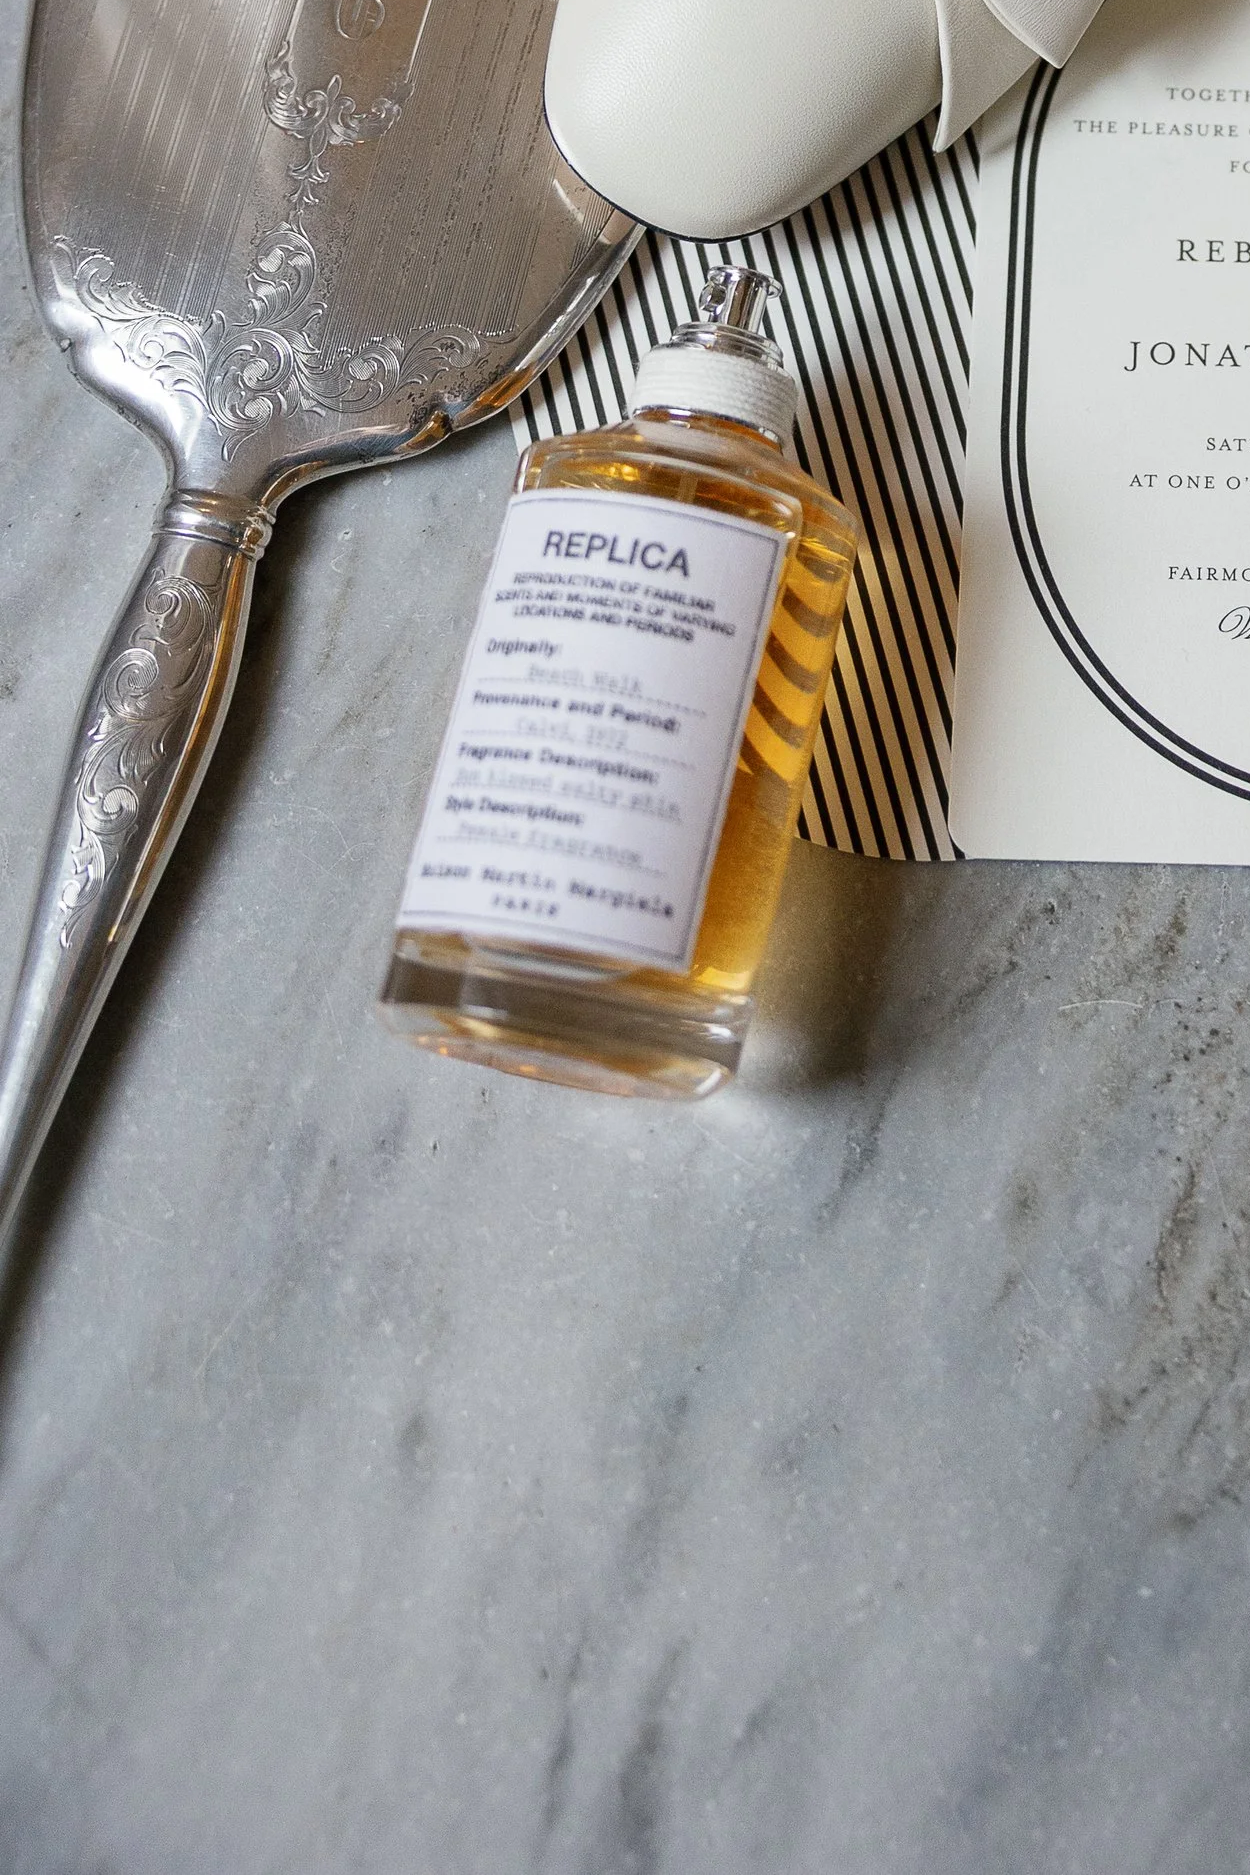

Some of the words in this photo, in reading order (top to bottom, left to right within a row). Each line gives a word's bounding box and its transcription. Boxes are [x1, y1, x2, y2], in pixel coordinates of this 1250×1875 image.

[1073, 119, 1118, 134] THE
[1128, 121, 1239, 138] PLEASURE
[1128, 473, 1158, 488] AT
[1168, 474, 1215, 490] ONE
[542, 529, 691, 578] REPLICA
[619, 579, 641, 595] OF
